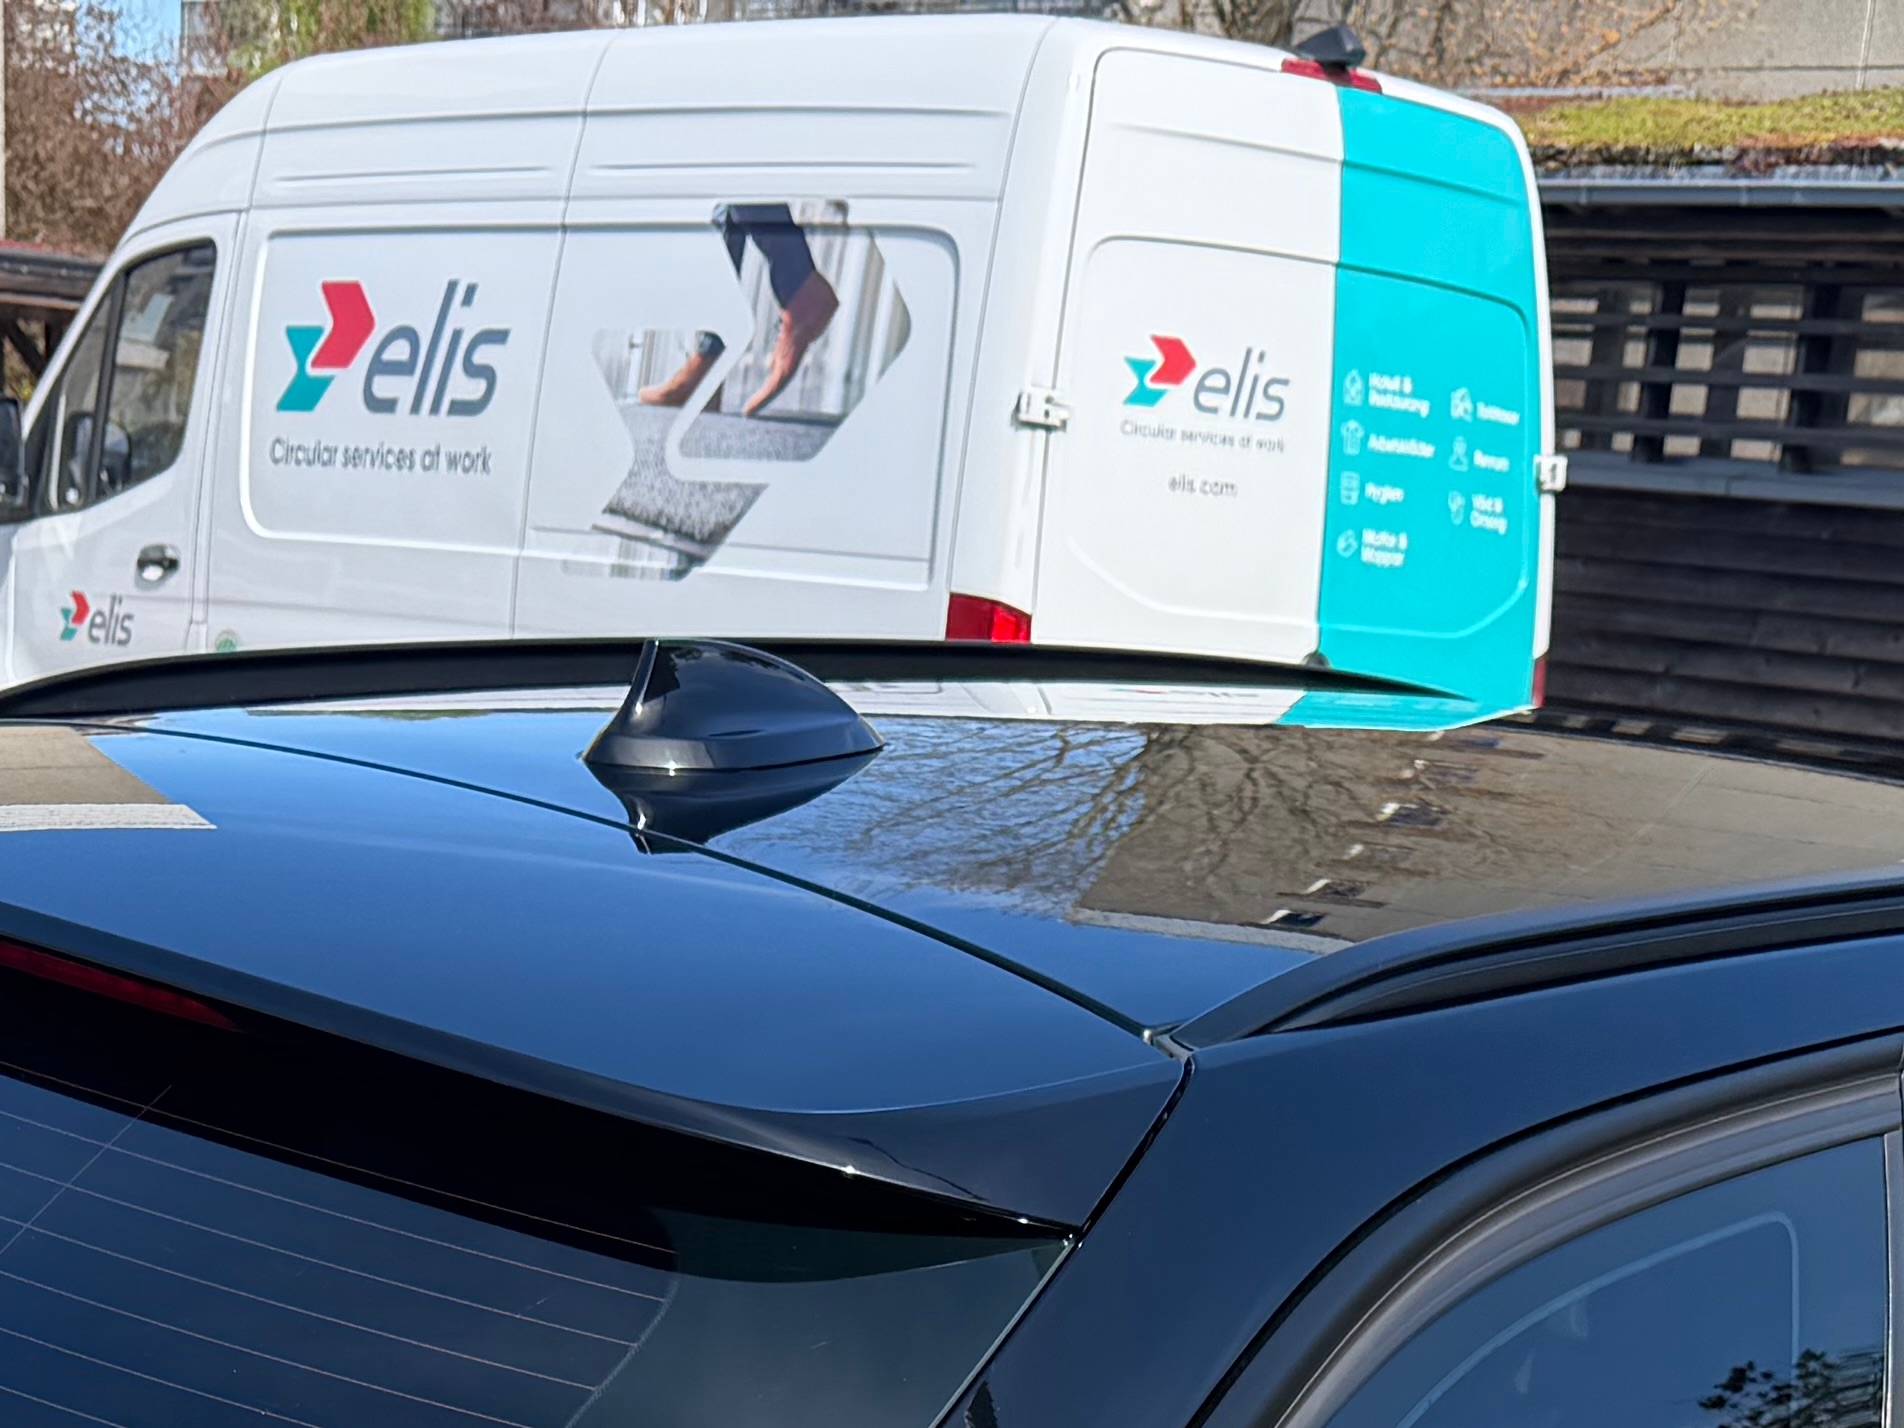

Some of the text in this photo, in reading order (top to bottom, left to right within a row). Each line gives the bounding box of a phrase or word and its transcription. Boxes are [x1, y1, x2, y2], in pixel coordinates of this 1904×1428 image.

[363, 279, 511, 417] elis
[1193, 347, 1291, 421] elis
[269, 437, 492, 475] Circular services at work
[87, 594, 135, 647] elis
